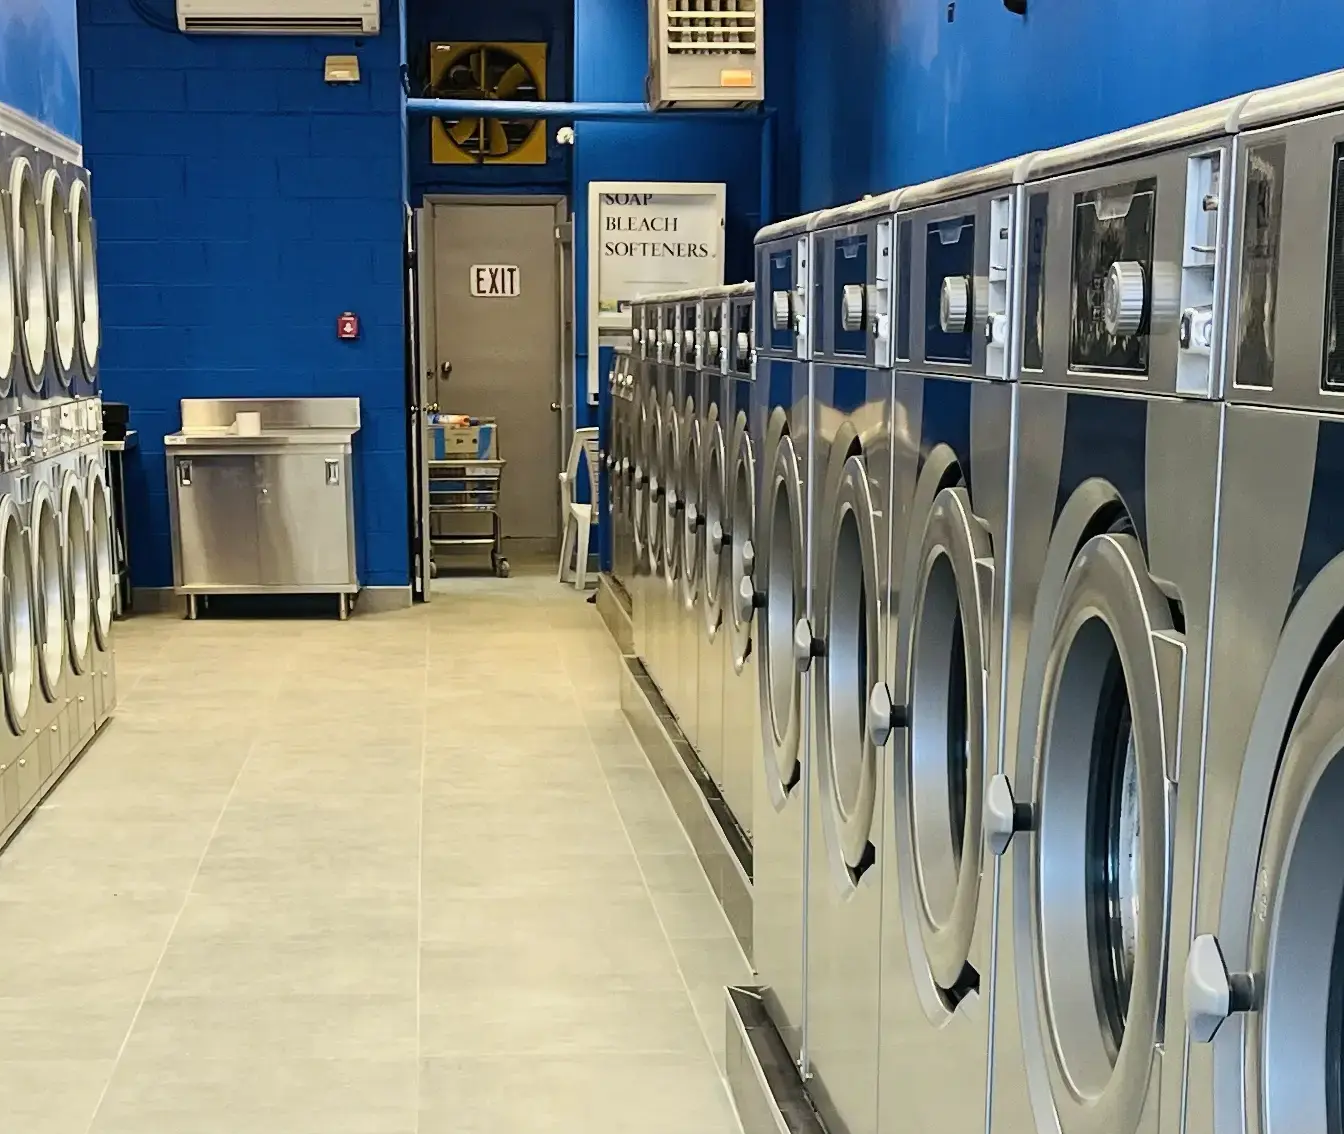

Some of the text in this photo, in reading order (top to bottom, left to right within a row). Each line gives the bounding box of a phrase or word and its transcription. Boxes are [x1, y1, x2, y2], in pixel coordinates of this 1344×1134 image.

[604, 193, 653, 206] SOAP
[605, 216, 678, 232] BLEACH
[476, 267, 517, 295] EXIT
